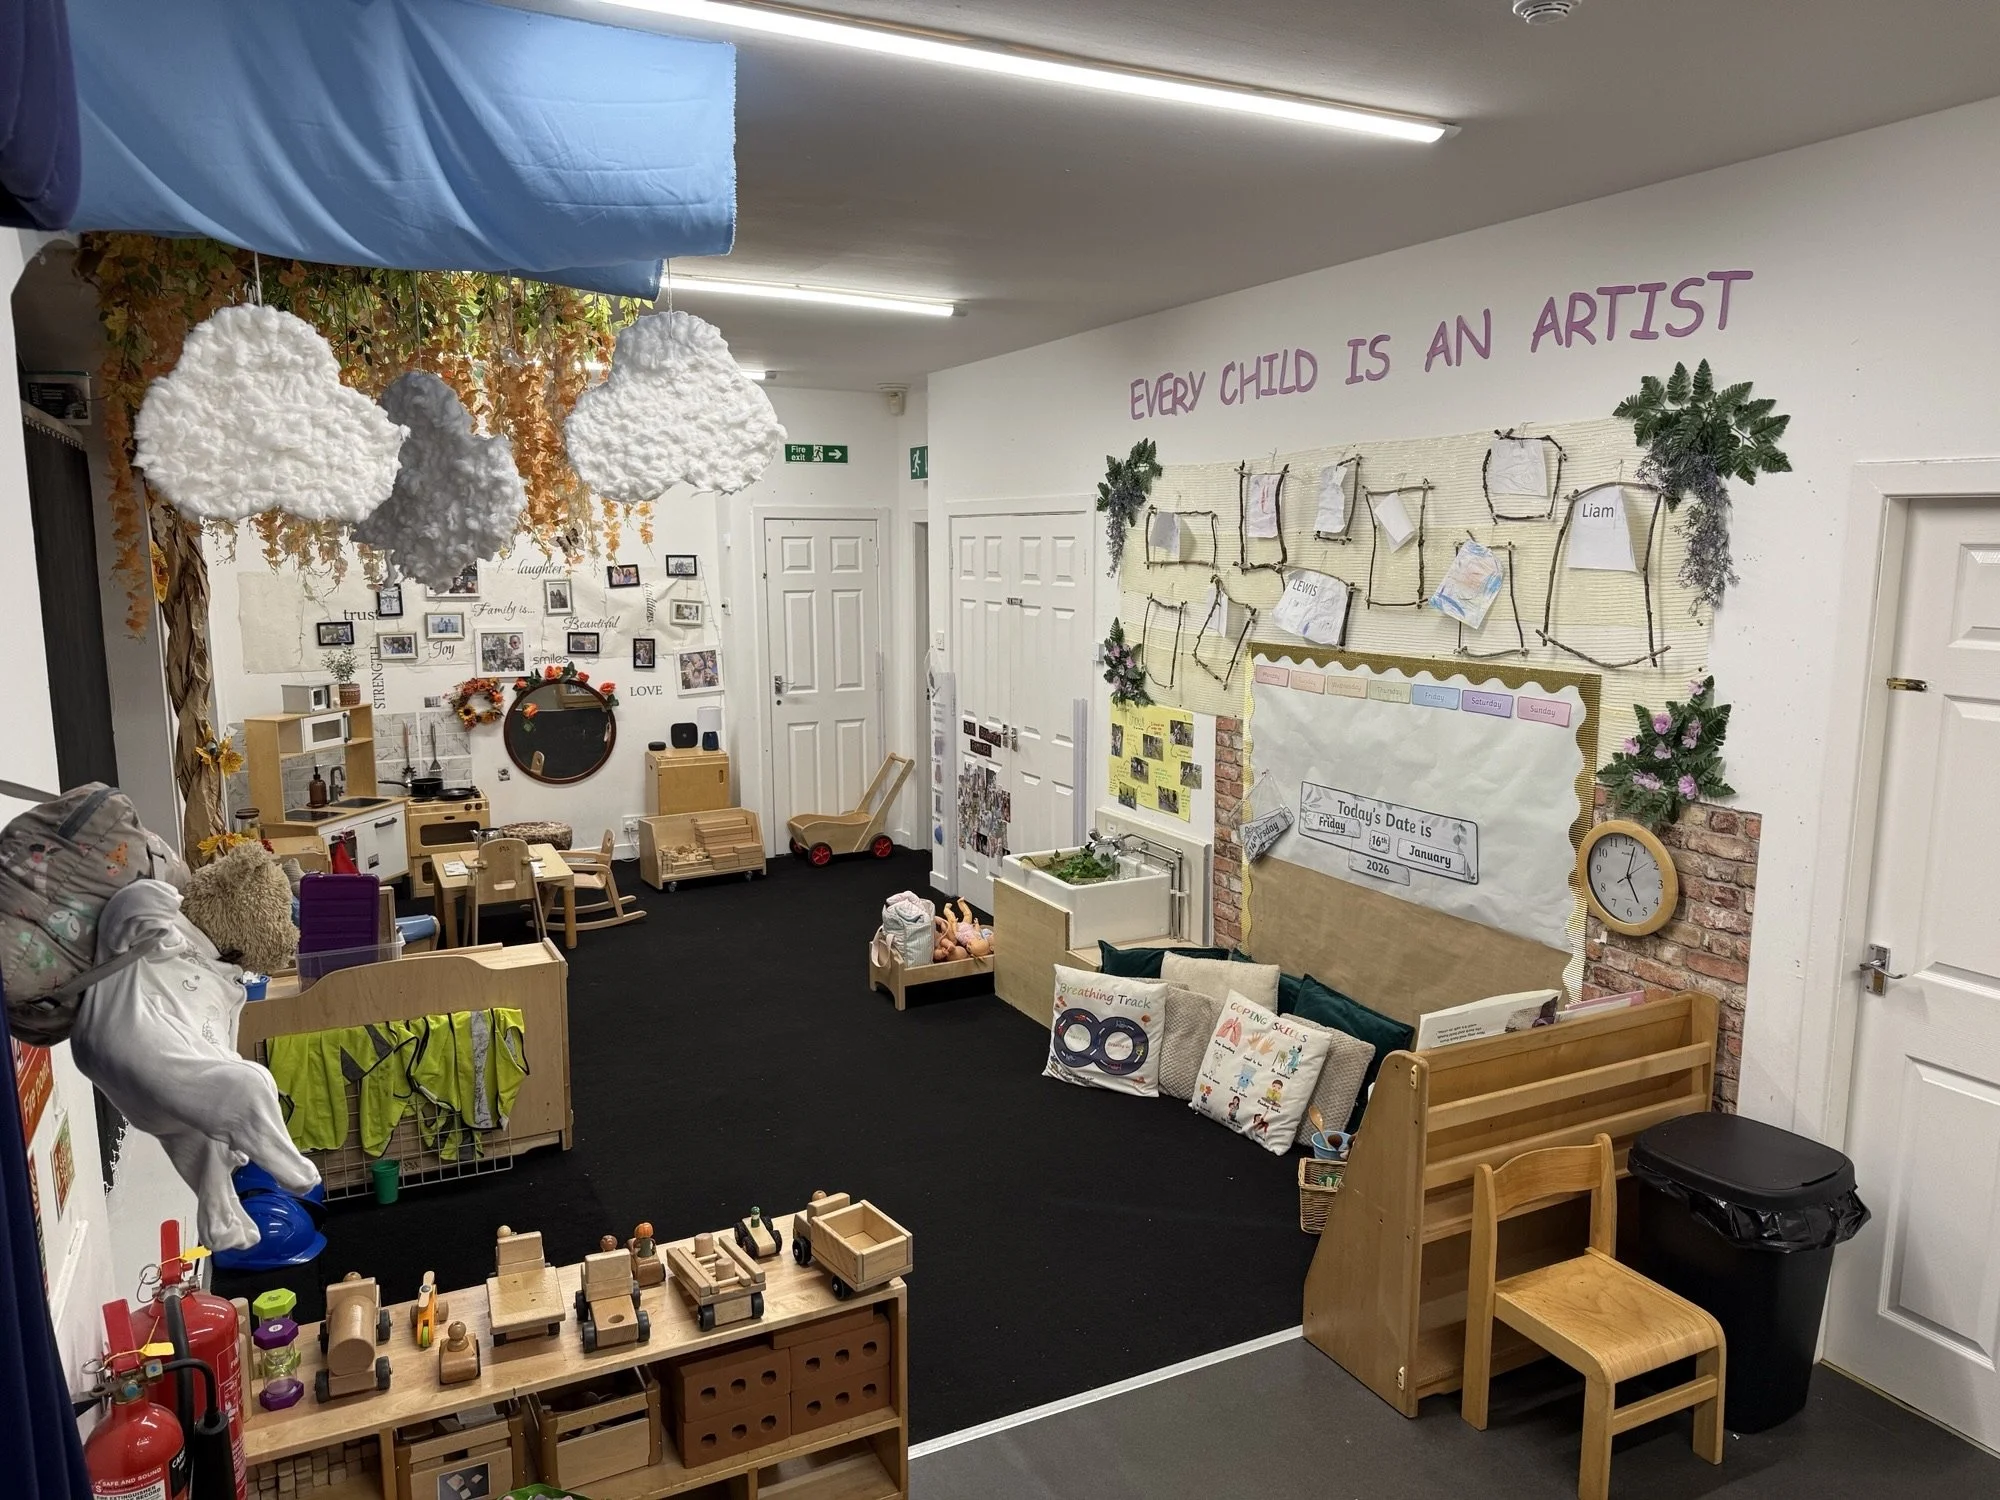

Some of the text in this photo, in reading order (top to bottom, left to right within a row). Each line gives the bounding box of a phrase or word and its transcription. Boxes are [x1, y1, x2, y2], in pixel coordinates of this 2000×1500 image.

[1130, 270, 1754, 420] EVERY CHILD IS AN ARTIST
[791, 445, 806, 454] Fire
[791, 453, 806, 462] exit
[1582, 503, 1614, 518] Liam
[517, 559, 564, 580] laughter
[1292, 579, 1319, 597] LEWIS
[344, 609, 381, 621] trust
[473, 601, 517, 621] Family
[562, 616, 621, 630] Beautiful
[429, 641, 456, 660] Joy
[533, 653, 569, 665] smiles
[370, 646, 386, 709] STRENGTH
[630, 685, 663, 697] LOVE
[1424, 691, 1445, 702] Friday
[1471, 697, 1502, 709] Saturday
[1530, 705, 1556, 718] Sunday
[1319, 816, 1346, 833] Friday
[1337, 800, 1432, 838] Today's Date is
[1371, 835, 1387, 847] 16th
[1610, 837, 1618, 848] 11
[1624, 836, 1634, 847] 12
[1409, 845, 1452, 869] January
[1598, 848, 1608, 858] 10
[1366, 860, 1390, 875] 2026
[1596, 864, 1602, 873] 9
[1653, 860, 1659, 870] 2
[1600, 883, 1606, 892] 8
[1658, 880, 1664, 890] 3
[1611, 898, 1617, 907] 7
[1653, 897, 1659, 907] 4
[1626, 907, 1632, 917] 6
[1642, 907, 1648, 916] 5
[1058, 982, 1151, 1009] Breathing Track
[1230, 1002, 1309, 1043] COPING SKILLS
[23, 1053, 50, 1125] Fire point
[120, 1477, 136, 1486] AND
[137, 1467, 162, 1481] SOUND
